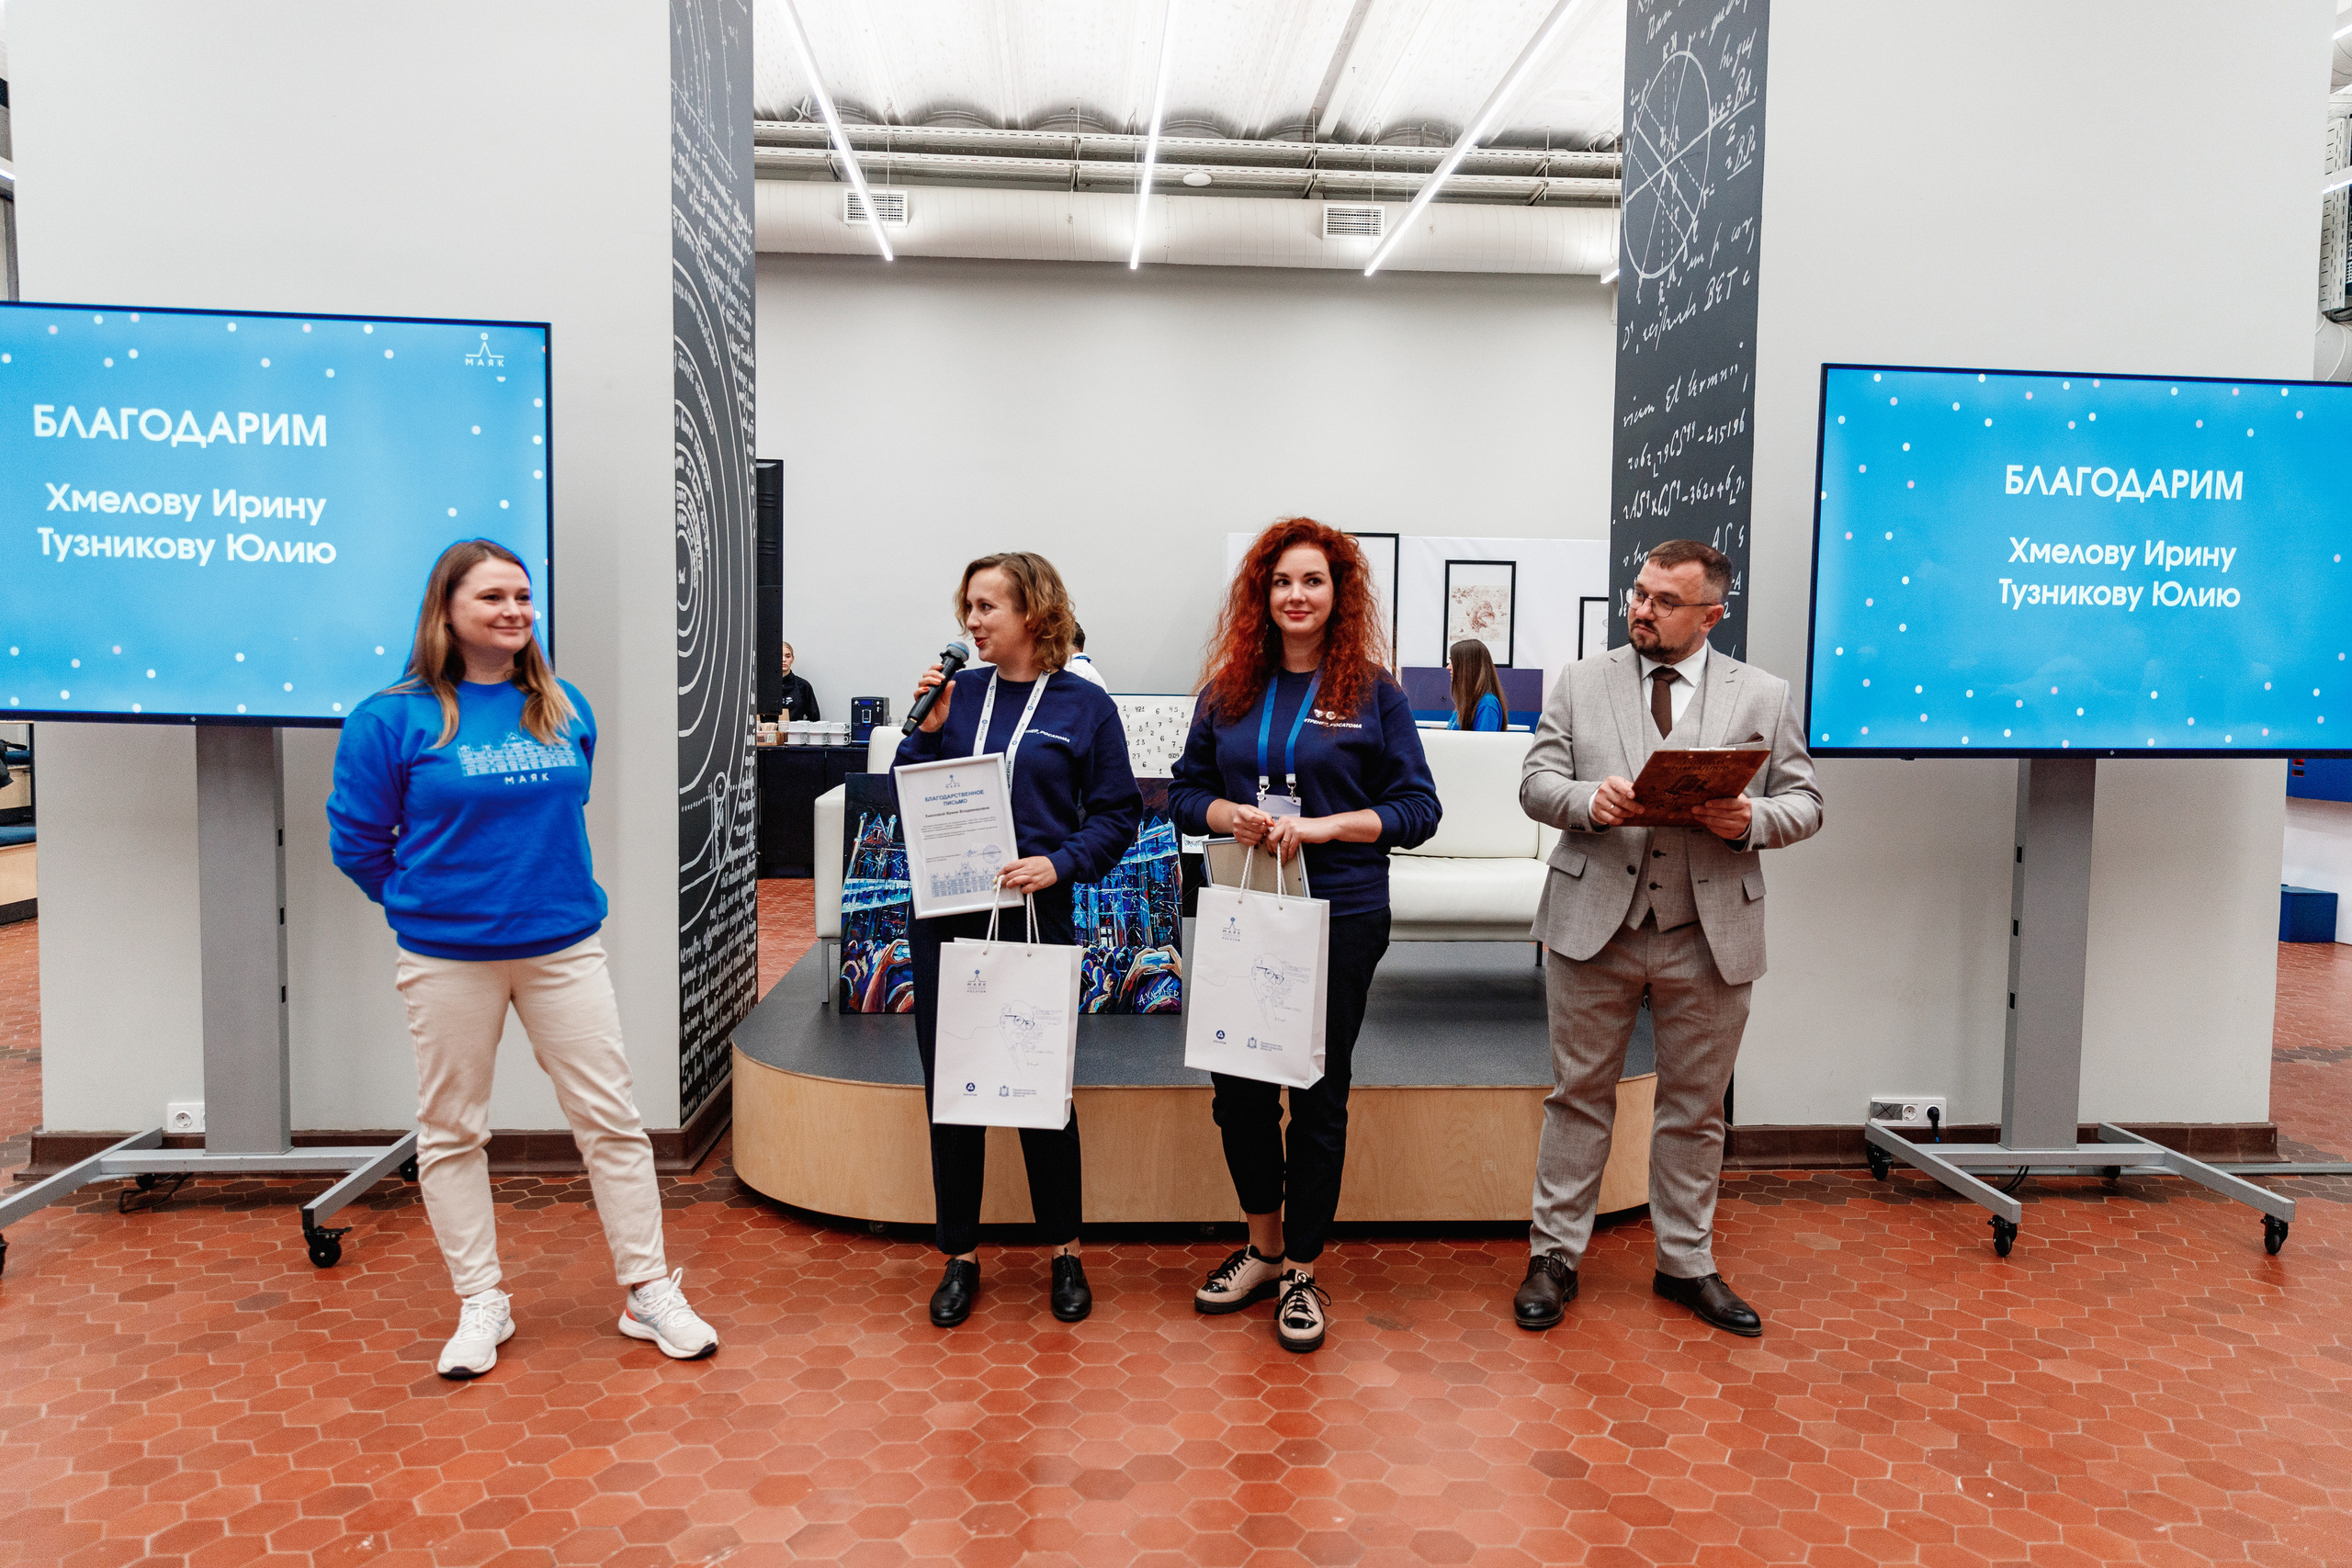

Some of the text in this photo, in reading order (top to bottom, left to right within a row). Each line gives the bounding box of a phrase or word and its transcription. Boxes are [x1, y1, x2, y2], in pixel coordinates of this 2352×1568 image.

[465, 358, 504, 367] МАЯК
[33, 404, 327, 448] БЛАГОДАРИМ
[2005, 465, 2244, 503] БЛАГОДАРИМ
[45, 483, 327, 525] Хмелову Ирину
[37, 527, 337, 567] Тузникову Юлию
[2008, 536, 2237, 573] Хмелову Ирину
[1998, 578, 2241, 612] Тузникову Юлию
[504, 773, 549, 784] МАЯК
[924, 789, 985, 802] БЛАГОДАРСТВЕННОЕ
